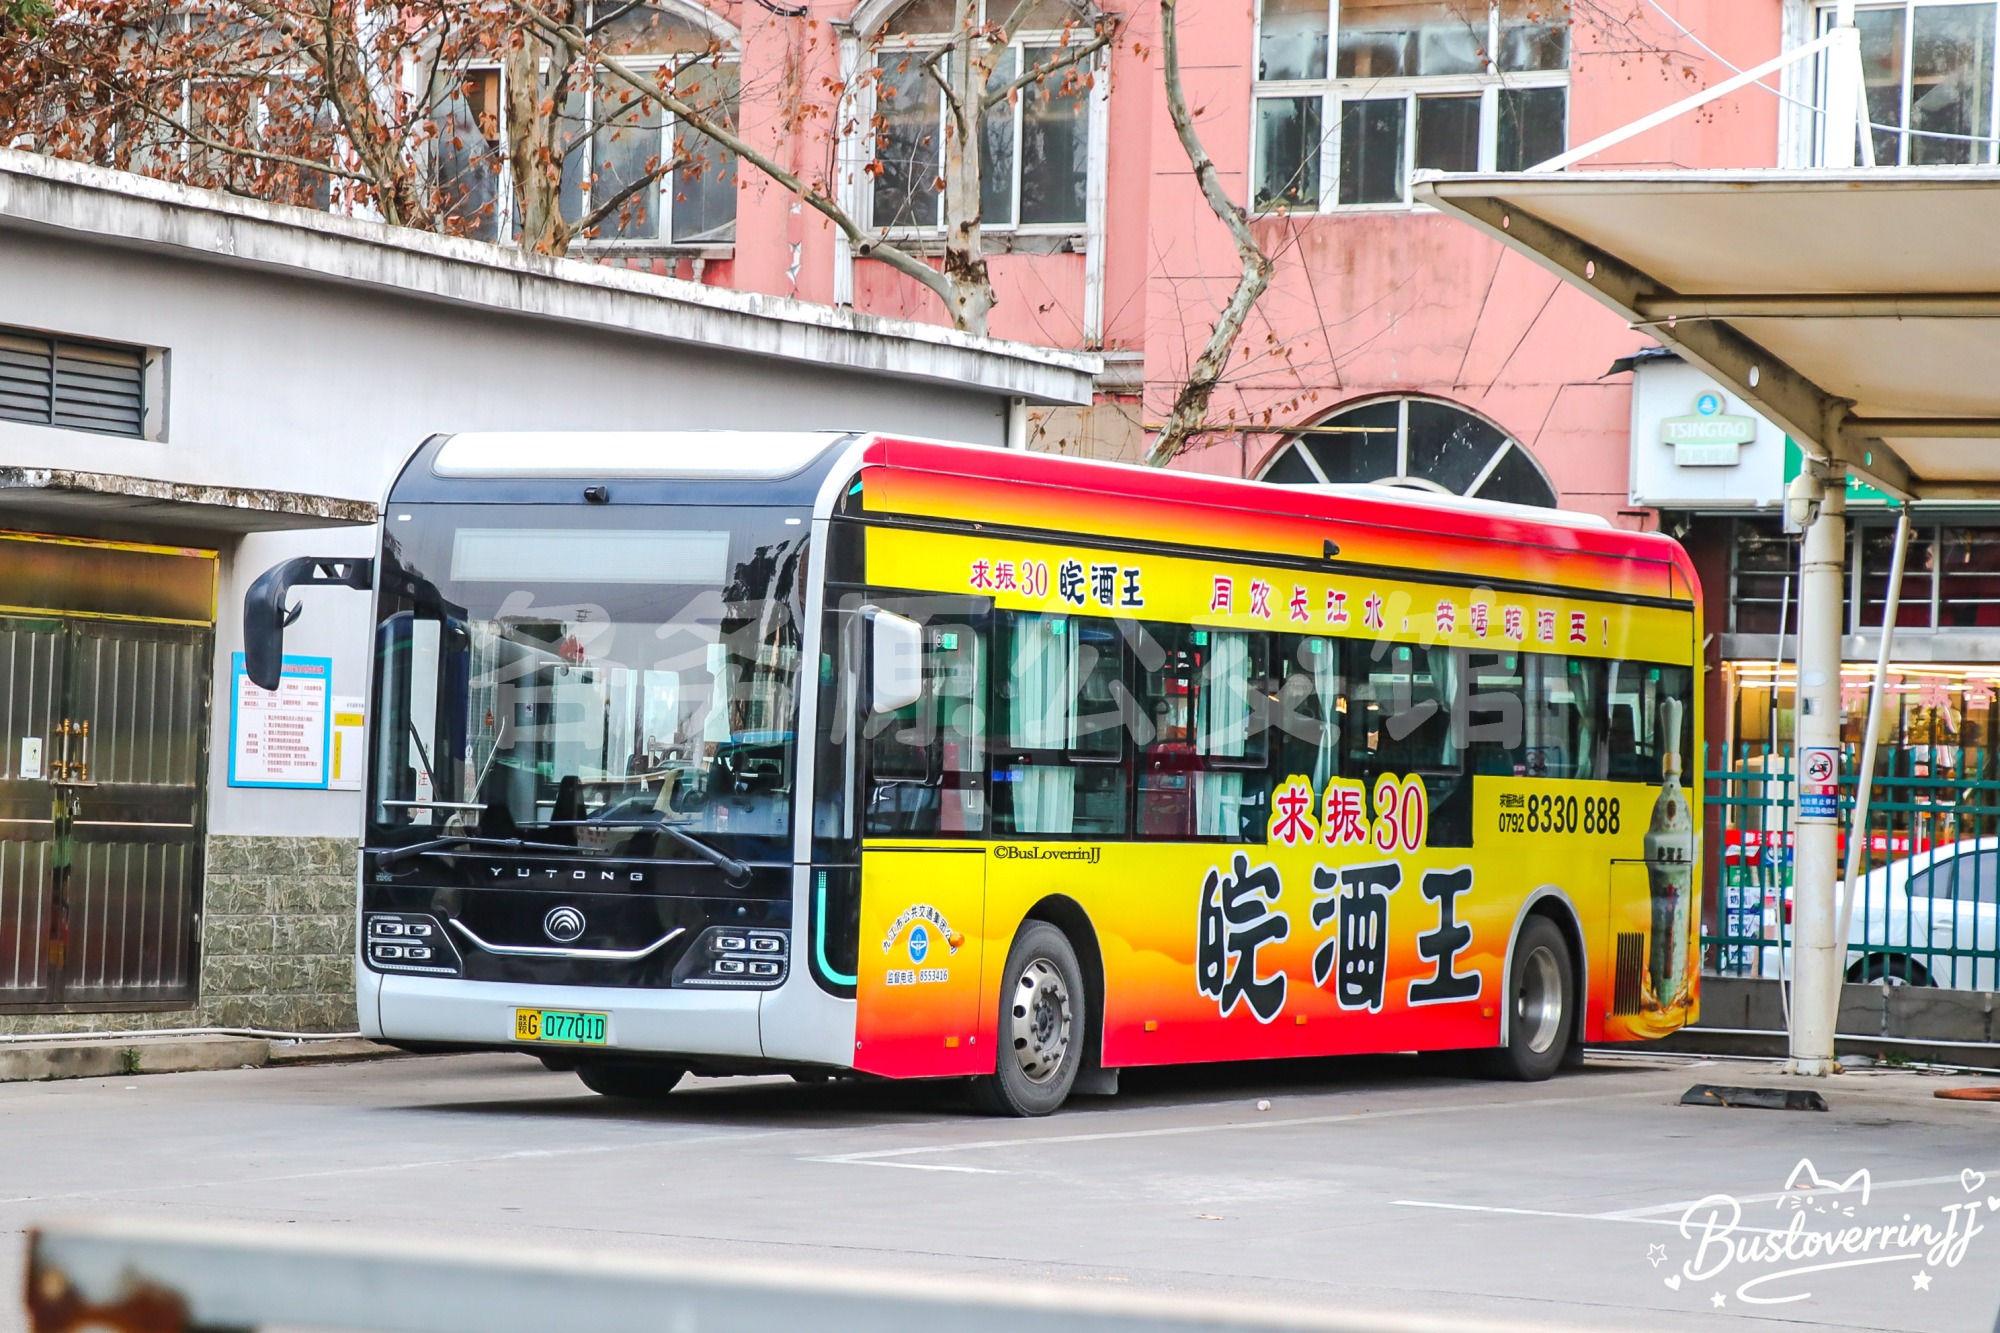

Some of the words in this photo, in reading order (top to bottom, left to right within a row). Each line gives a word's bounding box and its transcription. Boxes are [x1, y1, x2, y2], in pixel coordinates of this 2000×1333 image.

[1667, 421, 1747, 439] TSINGTAO
[970, 560, 1049, 597] 求振30
[1059, 560, 1144, 606] 皖酒王
[1273, 785, 1424, 851] 求振30
[1499, 812, 1525, 834] 0792
[1527, 794, 1579, 834] 8330
[1583, 796, 1621, 835] 888
[490, 867, 644, 881] YUTONG
[1200, 854, 1482, 1023] 皖酒王
[919, 969, 949, 982] 8553416
